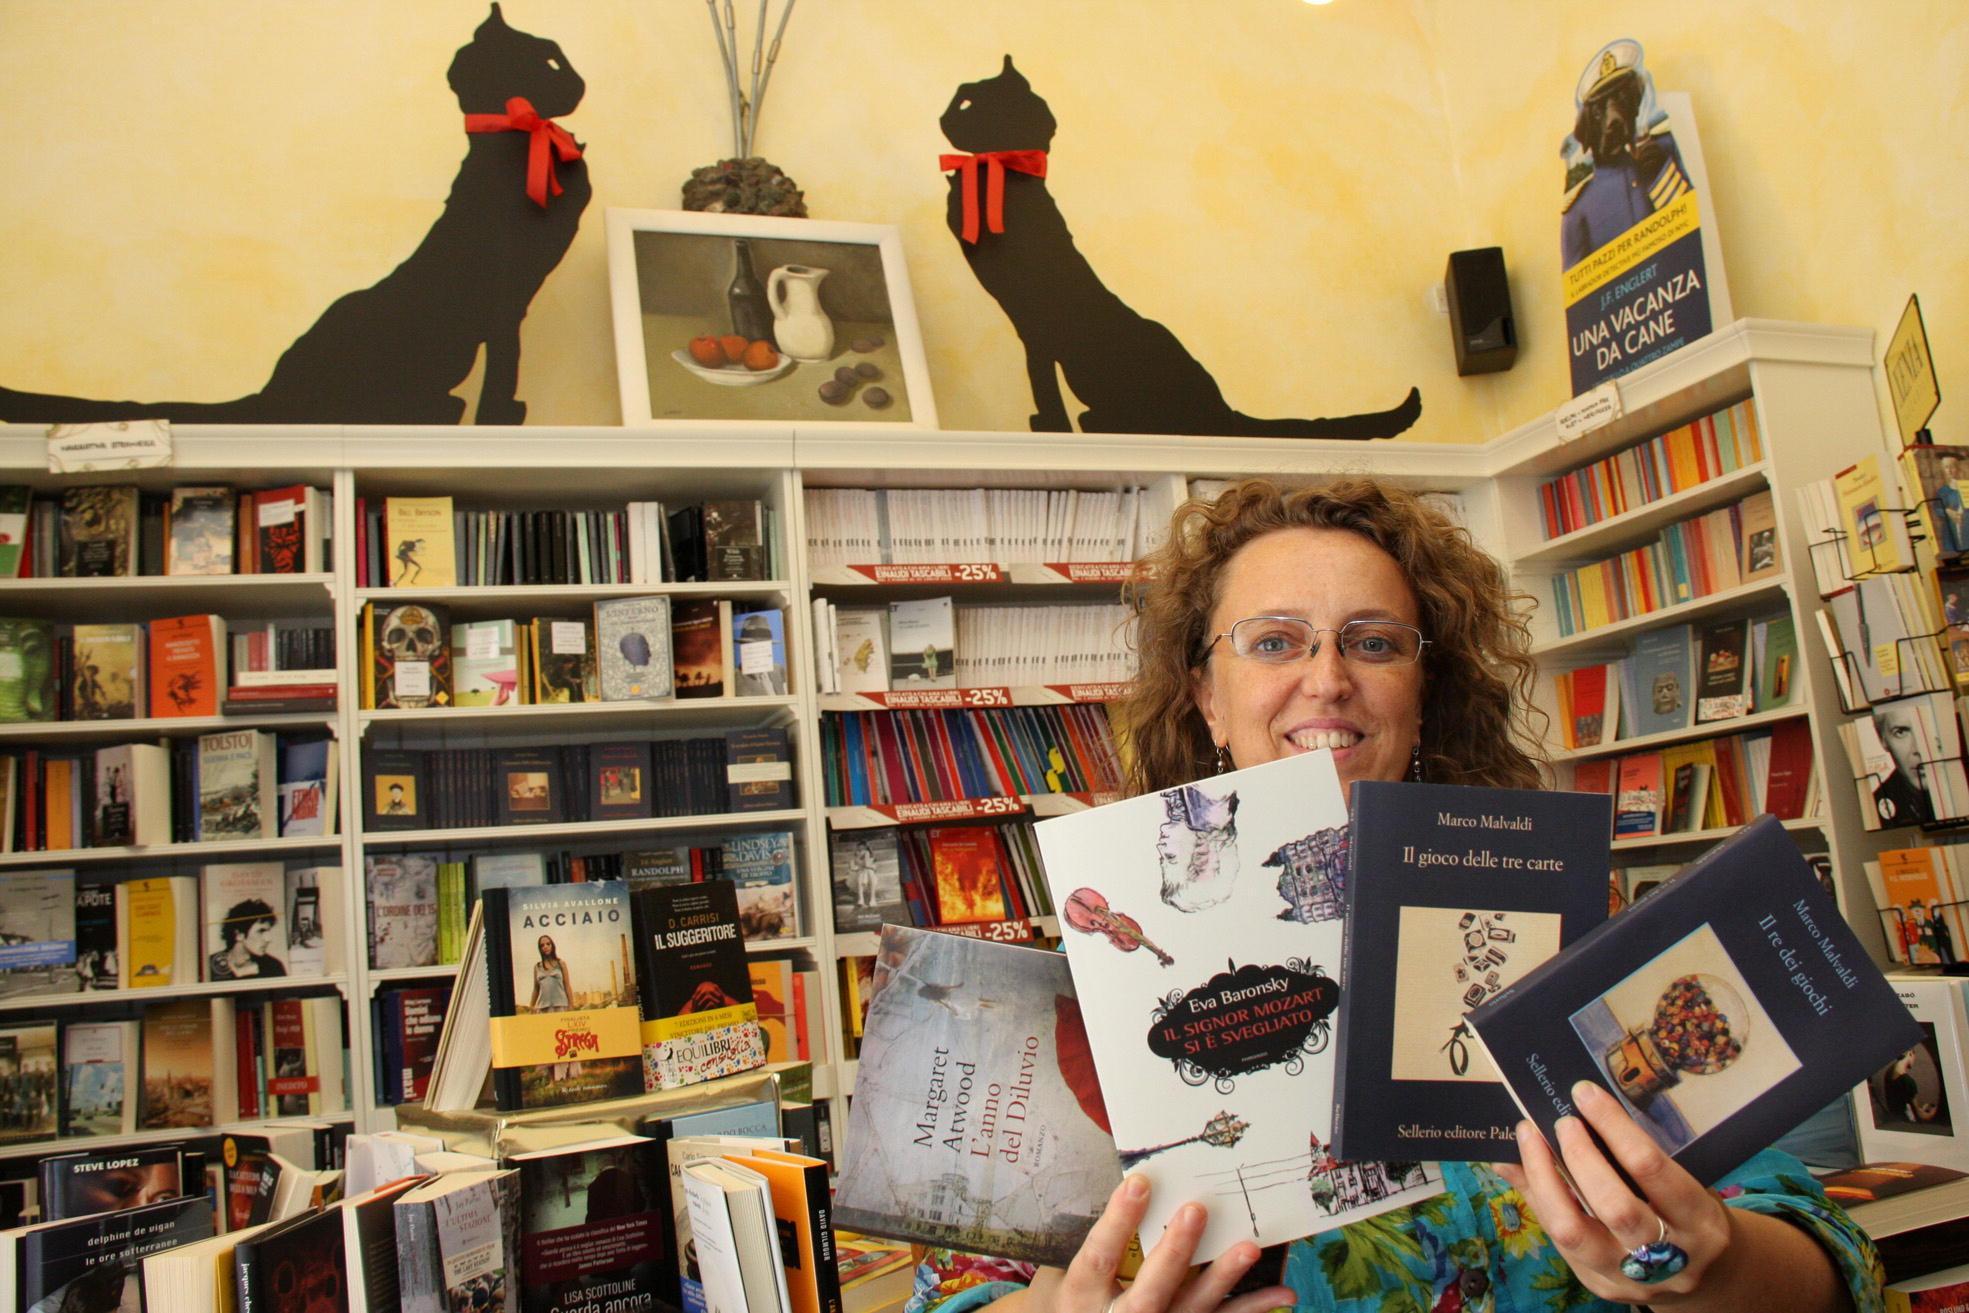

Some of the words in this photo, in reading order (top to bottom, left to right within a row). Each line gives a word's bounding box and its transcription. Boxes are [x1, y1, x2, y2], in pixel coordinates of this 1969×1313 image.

[1593, 249, 1615, 268] PAZZI
[1617, 238, 1633, 254] PER
[1634, 203, 1687, 242] RANDOLPH!
[1615, 263, 1658, 300] ENGLERT
[1572, 320, 1610, 357] UNA
[1610, 269, 1701, 334] VACANZA
[1596, 341, 1622, 370] DA
[1624, 310, 1676, 354] CANE
[954, 564, 997, 580] -25%
[965, 689, 1008, 705] -25%
[976, 797, 1019, 813] -25%
[1437, 812, 1477, 829] Marco
[1480, 814, 1533, 832] Malvaldi
[731, 837, 778, 852] LINDSEY
[739, 849, 773, 862] DAVIS
[631, 865, 685, 877] RANDOLPH
[1403, 846, 1414, 864] Il
[1418, 848, 1458, 869] gioco
[1462, 850, 1498, 868] delle
[1502, 854, 1524, 870] tre
[1526, 856, 1564, 872] carte
[77, 892, 112, 907] APOTE
[522, 901, 558, 912] SILVIA
[564, 897, 619, 908] AVALLONE
[523, 909, 620, 929] ACCIAIO
[680, 912, 720, 928] CARRISI
[985, 921, 1028, 940] -25%
[654, 933, 667, 951] IL
[666, 923, 737, 949] SUGGERITORE
[1792, 899, 1821, 938] Marco
[1818, 937, 1859, 990] Malvaldi
[1757, 913, 1777, 931] Il
[1768, 930, 1783, 948] re
[1778, 948, 1803, 972] dei
[1791, 970, 1833, 1017] giochi
[1189, 996, 1217, 1014] Eva
[1220, 976, 1290, 1006] Baronsky
[1163, 1028, 1181, 1042] IL
[1183, 1008, 1249, 1038] SIGNOR
[1253, 986, 1324, 1018] MOZART
[1184, 1039, 1200, 1055] SI
[1205, 1032, 1218, 1049] È
[1221, 1009, 1313, 1046] SVEGLIATO
[676, 1039, 731, 1064] EQUILIBRI
[1006, 1036, 1040, 1122] Diluvio
[1525, 1052, 1556, 1096] Sellerio
[912, 1045, 949, 1149] Margaret
[942, 1061, 976, 1153] Atwood
[970, 1083, 1001, 1159] L'anno
[1397, 1124, 1441, 1139] Sellerio
[1444, 1125, 1487, 1140] editore
[1489, 1126, 1516, 1141] Pale
[1000, 1130, 1023, 1164] del
[1034, 1123, 1046, 1168] ROMANZO
[73, 1161, 104, 1174] STEVE
[107, 1158, 139, 1171] LOPEZ
[818, 1209, 827, 1230] DAVID
[87, 1229, 132, 1247] delphine
[134, 1226, 146, 1237] de
[149, 1220, 175, 1235] vigan
[821, 1230, 831, 1262] GILMOUR
[85, 1257, 96, 1267] le
[98, 1252, 117, 1265] ore
[119, 1238, 178, 1260] sotterranee
[564, 1290, 584, 1305] LISA
[585, 1278, 637, 1300] SCOTTOLINE
[605, 1292, 652, 1313] ancora
